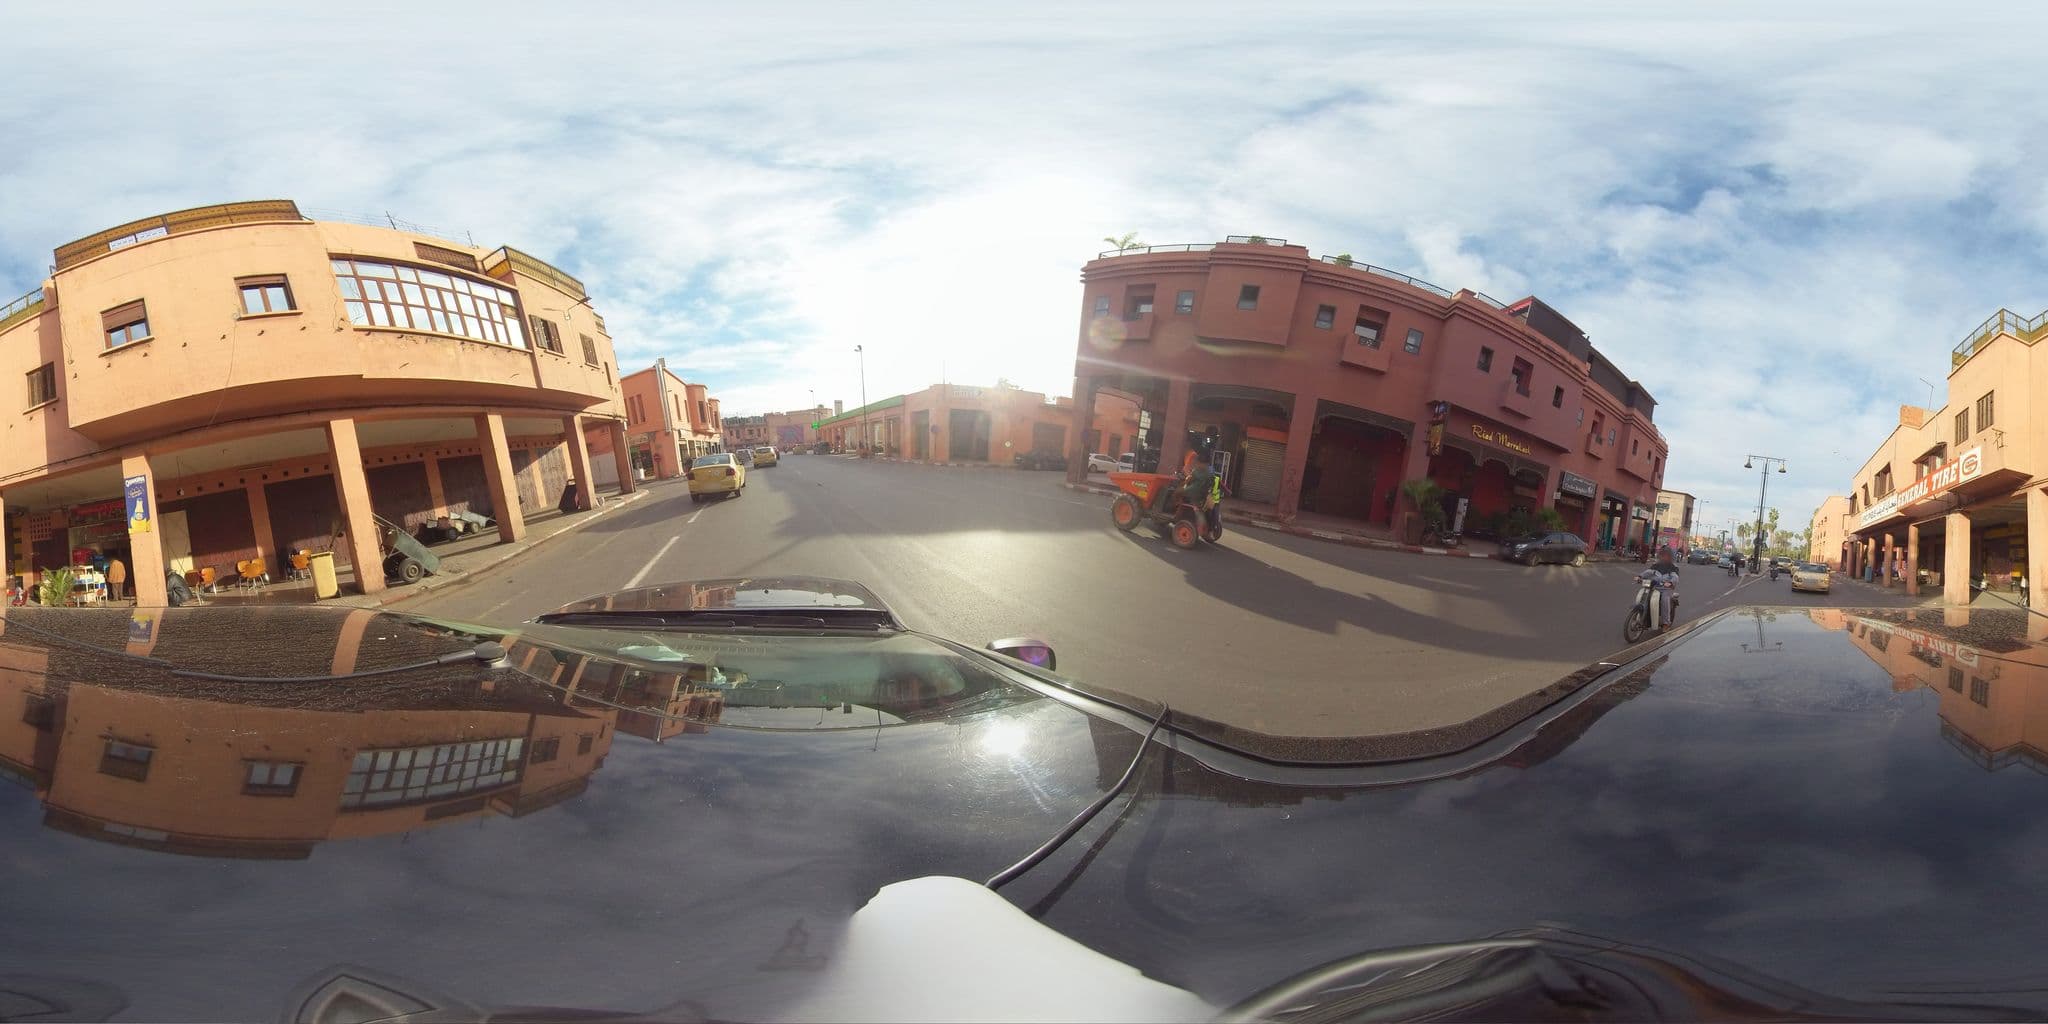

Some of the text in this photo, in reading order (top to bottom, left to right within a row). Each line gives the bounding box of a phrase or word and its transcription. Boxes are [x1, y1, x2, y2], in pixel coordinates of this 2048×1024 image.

[1471, 424, 1494, 442] Riad
[1897, 462, 1958, 507] GENERAL TIRE
